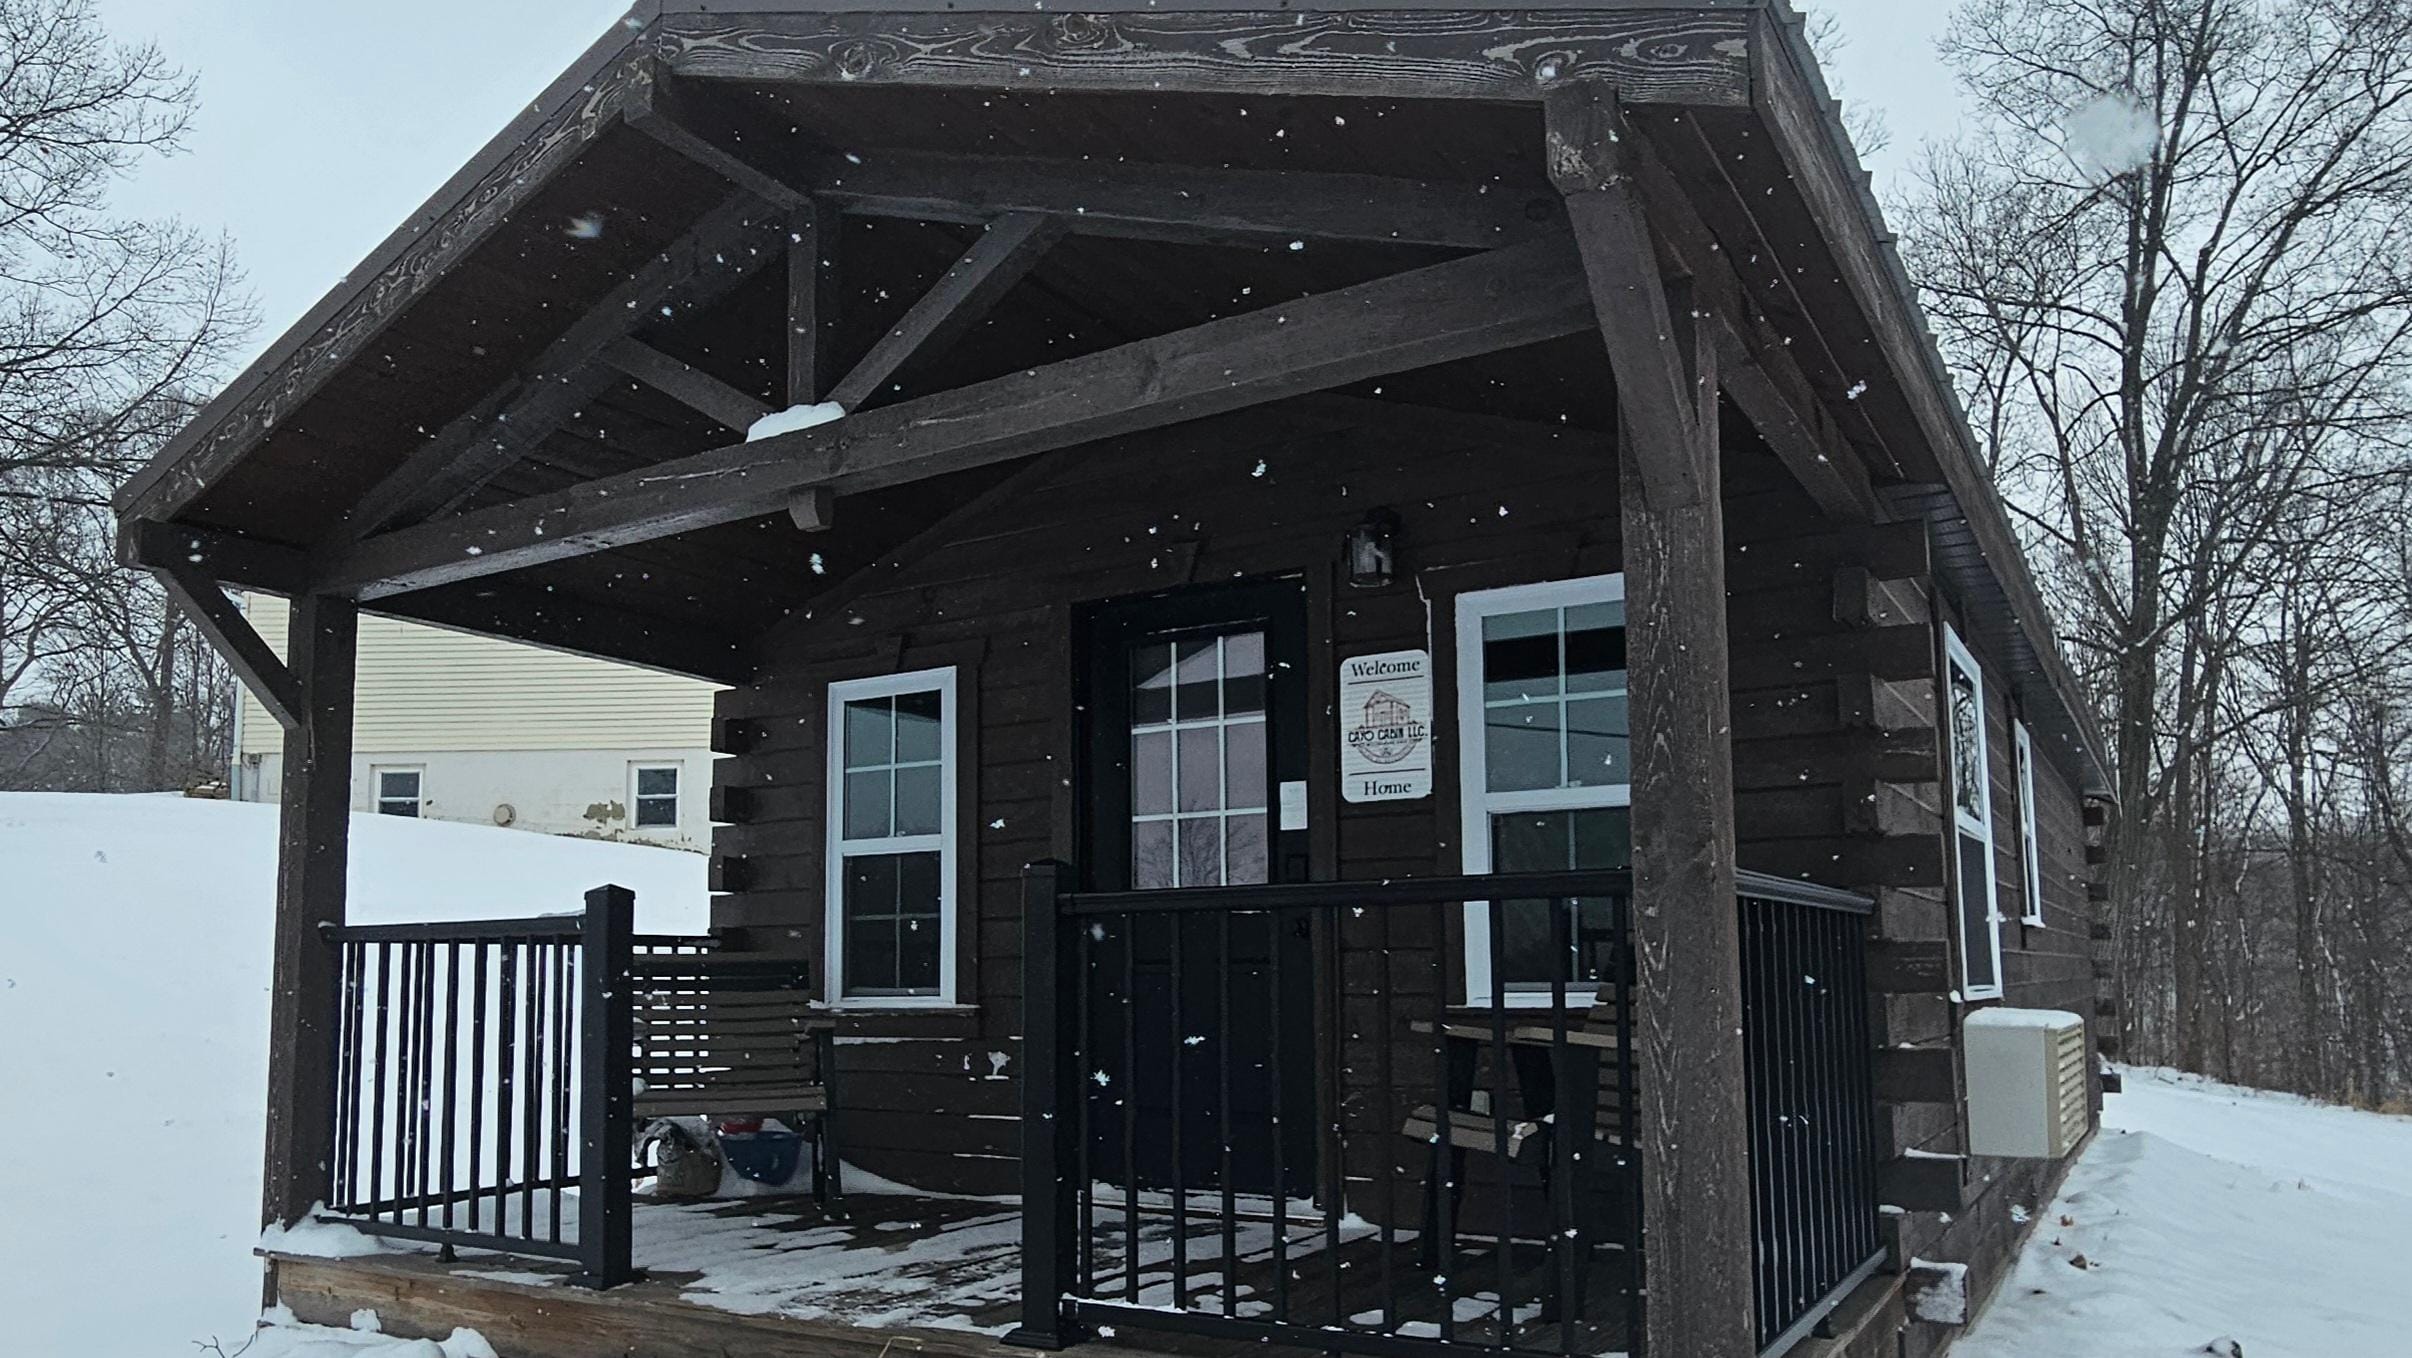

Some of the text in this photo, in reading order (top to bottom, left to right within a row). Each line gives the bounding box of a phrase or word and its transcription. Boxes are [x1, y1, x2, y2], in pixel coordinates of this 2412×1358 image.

[1351, 660, 1420, 677] Welcome
[1378, 726, 1404, 740] CABIN
[1364, 780, 1412, 796] Home
